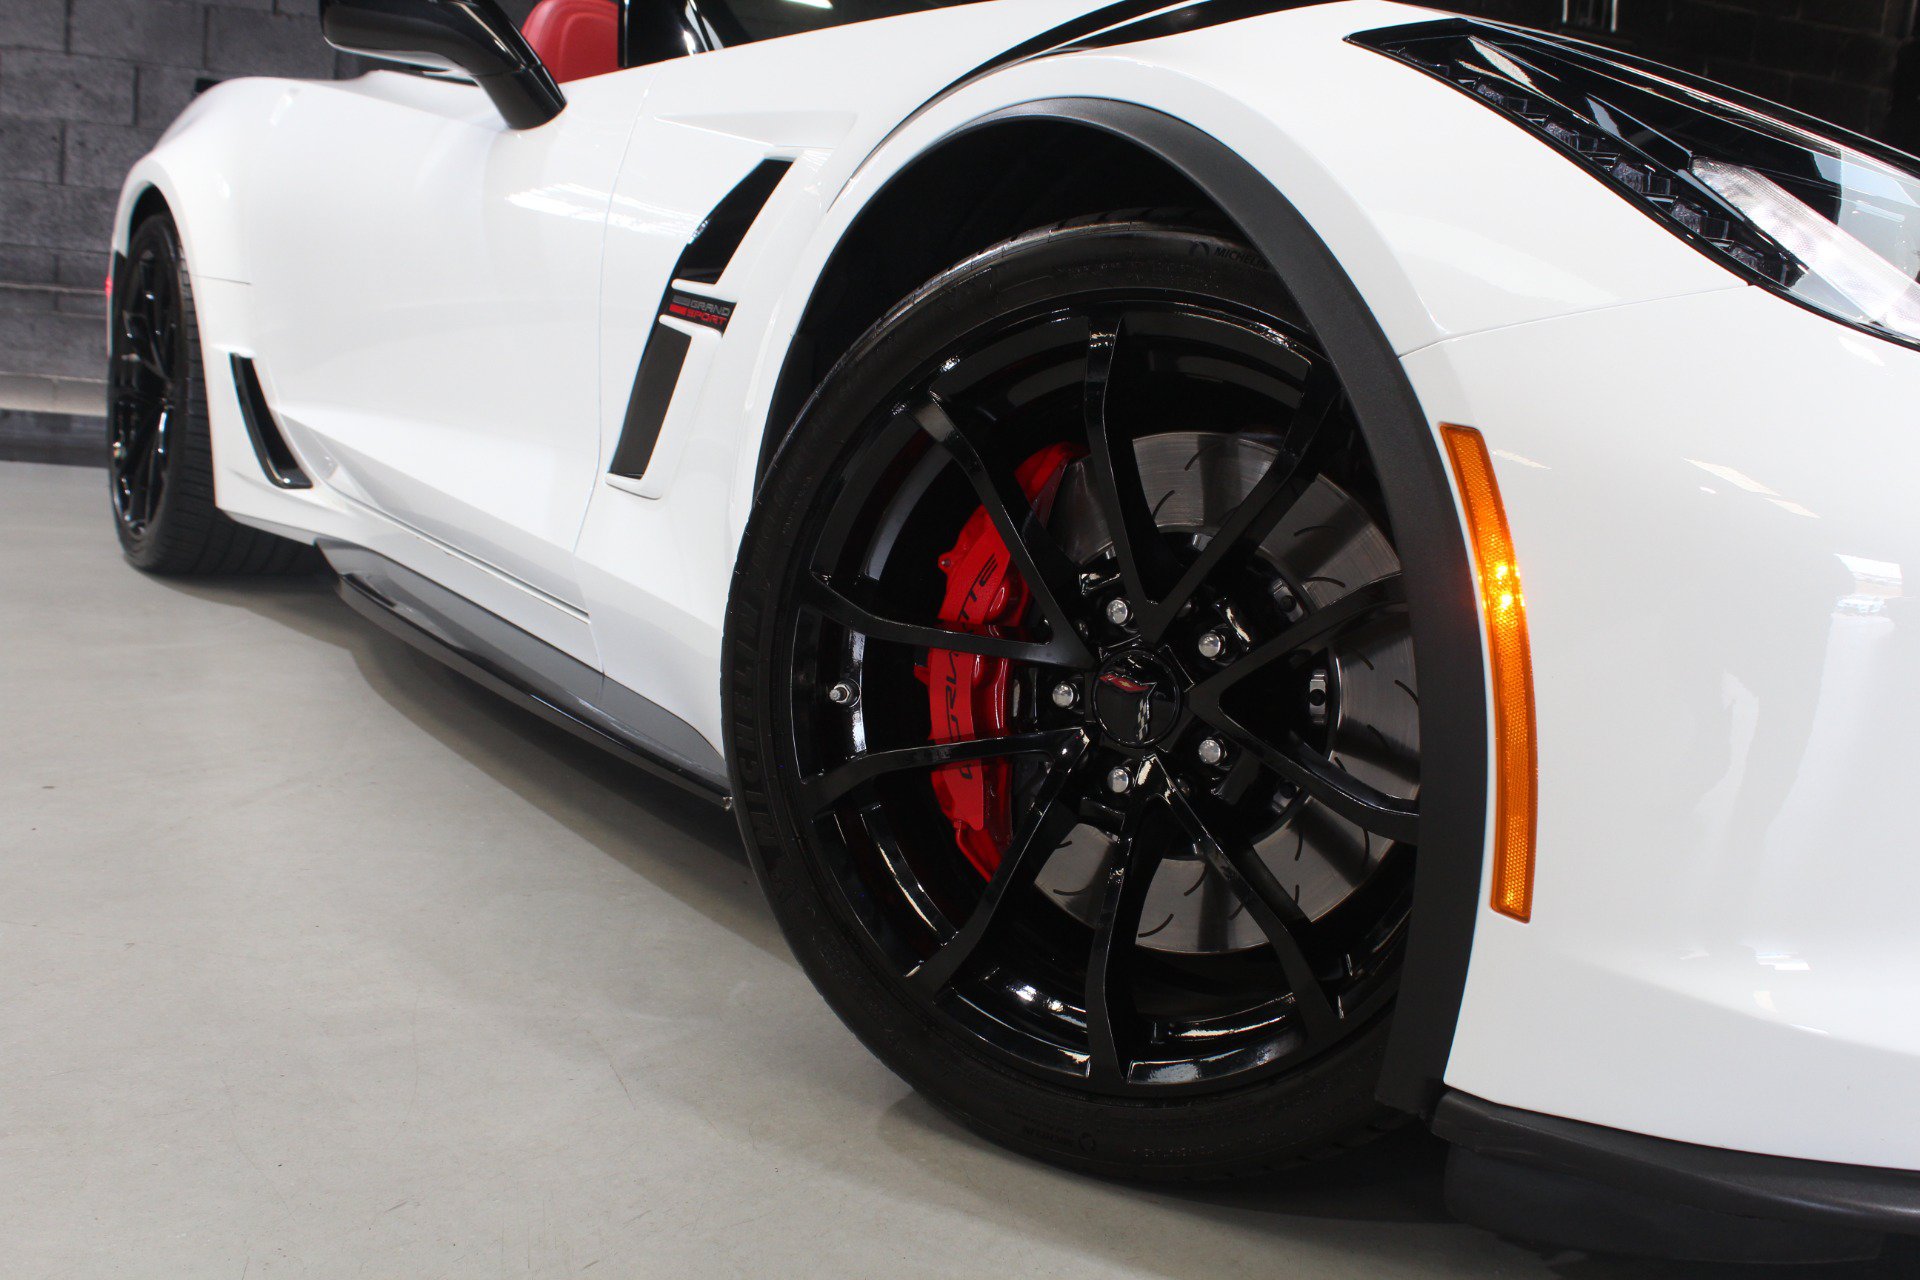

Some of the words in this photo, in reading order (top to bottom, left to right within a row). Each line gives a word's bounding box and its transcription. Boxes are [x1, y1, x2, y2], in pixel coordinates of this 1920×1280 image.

[1214, 246, 1267, 270] MICHELIN
[687, 307, 727, 325] SPORT
[690, 300, 730, 316] GRAND
[946, 553, 998, 779] ORVTTE
[734, 600, 777, 847] MICHELIN
